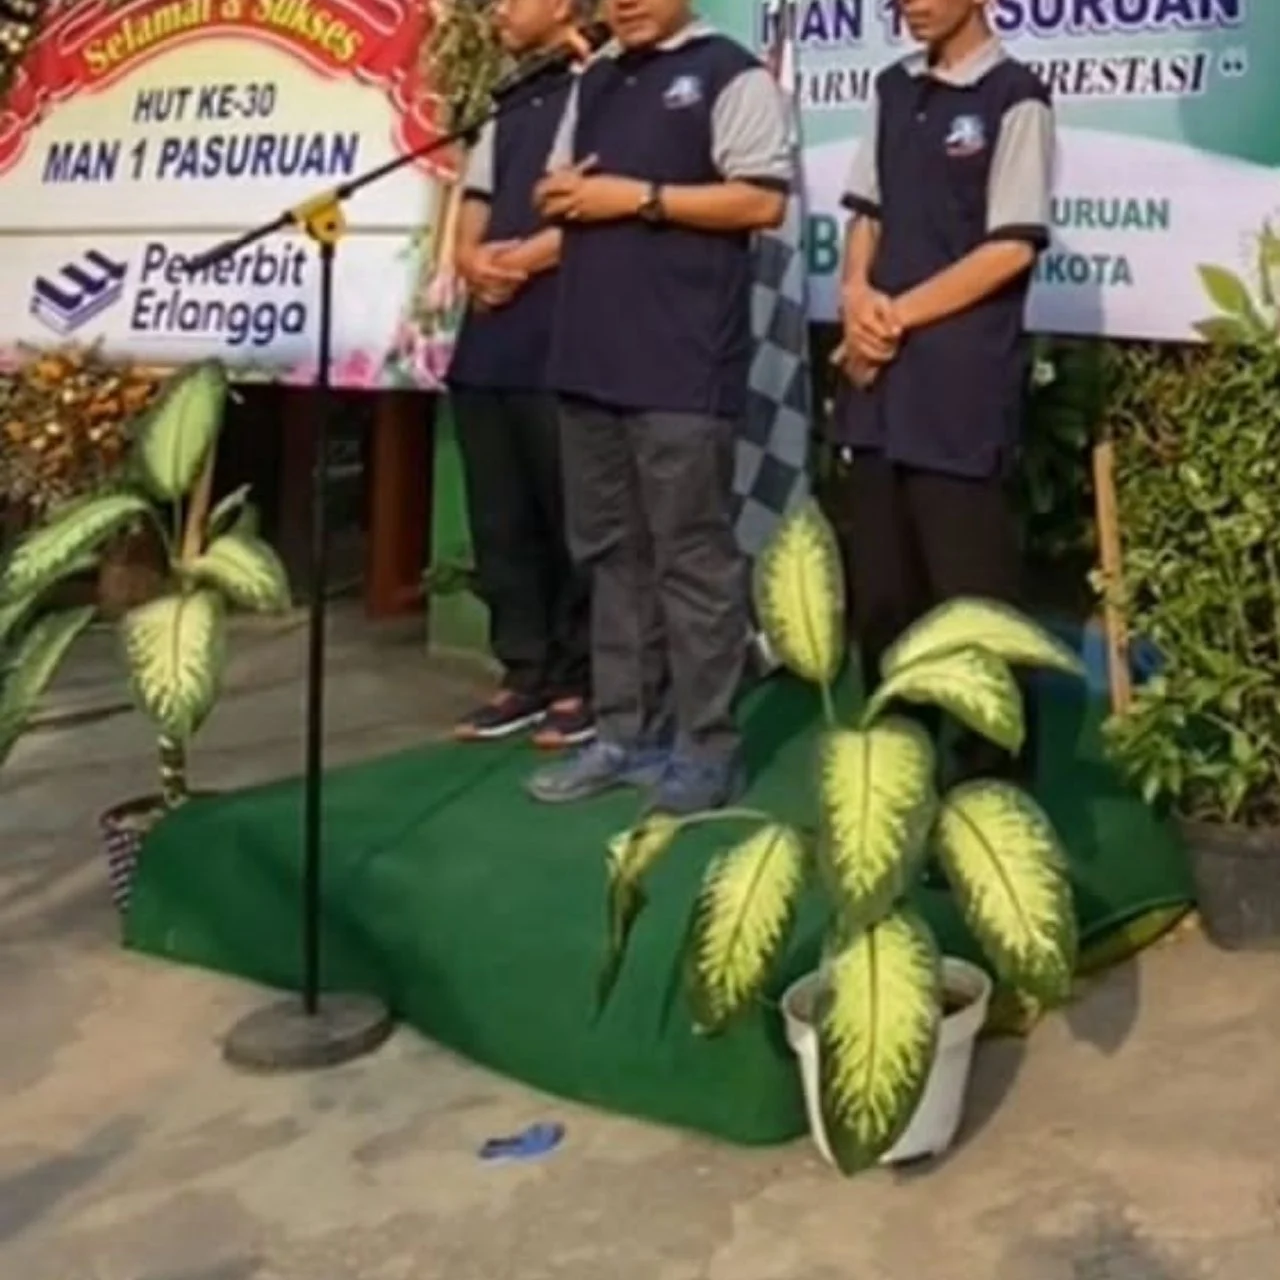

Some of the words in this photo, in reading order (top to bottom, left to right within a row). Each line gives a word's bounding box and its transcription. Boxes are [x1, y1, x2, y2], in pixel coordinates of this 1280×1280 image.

[134, 87, 189, 123] HUT
[196, 83, 277, 121] KE-30
[42, 138, 122, 184] MAN
[129, 136, 147, 181] 1
[155, 131, 360, 181] PASURUAN
[1050, 197, 1170, 230] URUAN
[131, 288, 307, 347] Erlangga
